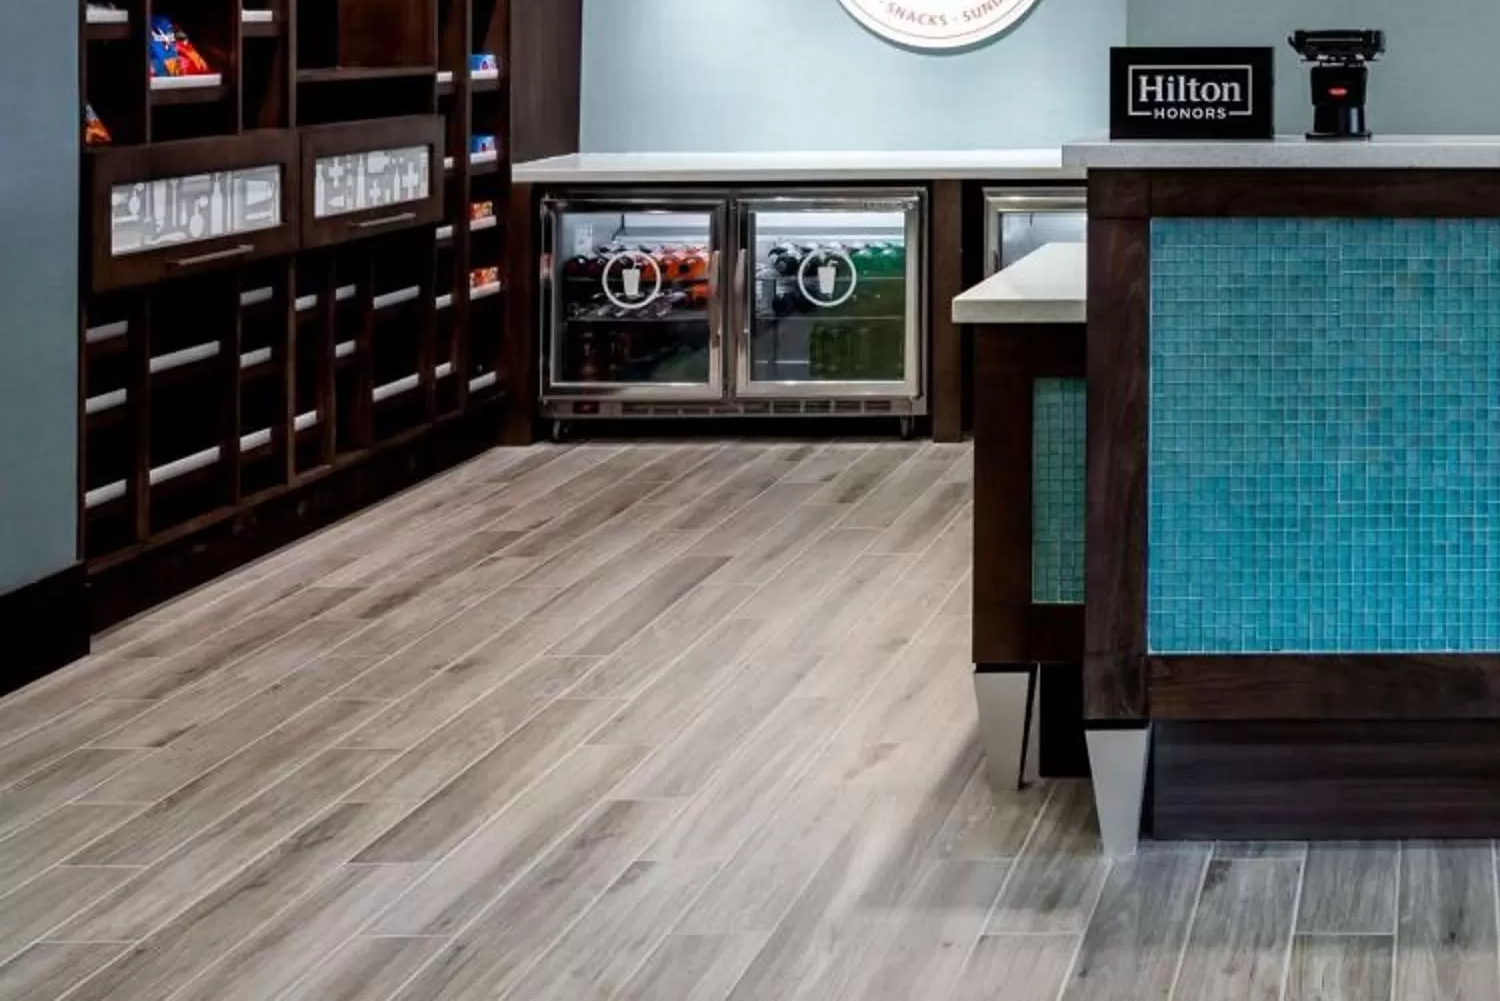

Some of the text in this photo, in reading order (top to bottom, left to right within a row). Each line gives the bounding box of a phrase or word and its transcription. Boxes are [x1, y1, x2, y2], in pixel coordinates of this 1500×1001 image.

[886, 1, 949, 27] SNACKS
[1138, 74, 1241, 102] Hilton
[1153, 107, 1228, 120] HONORS
